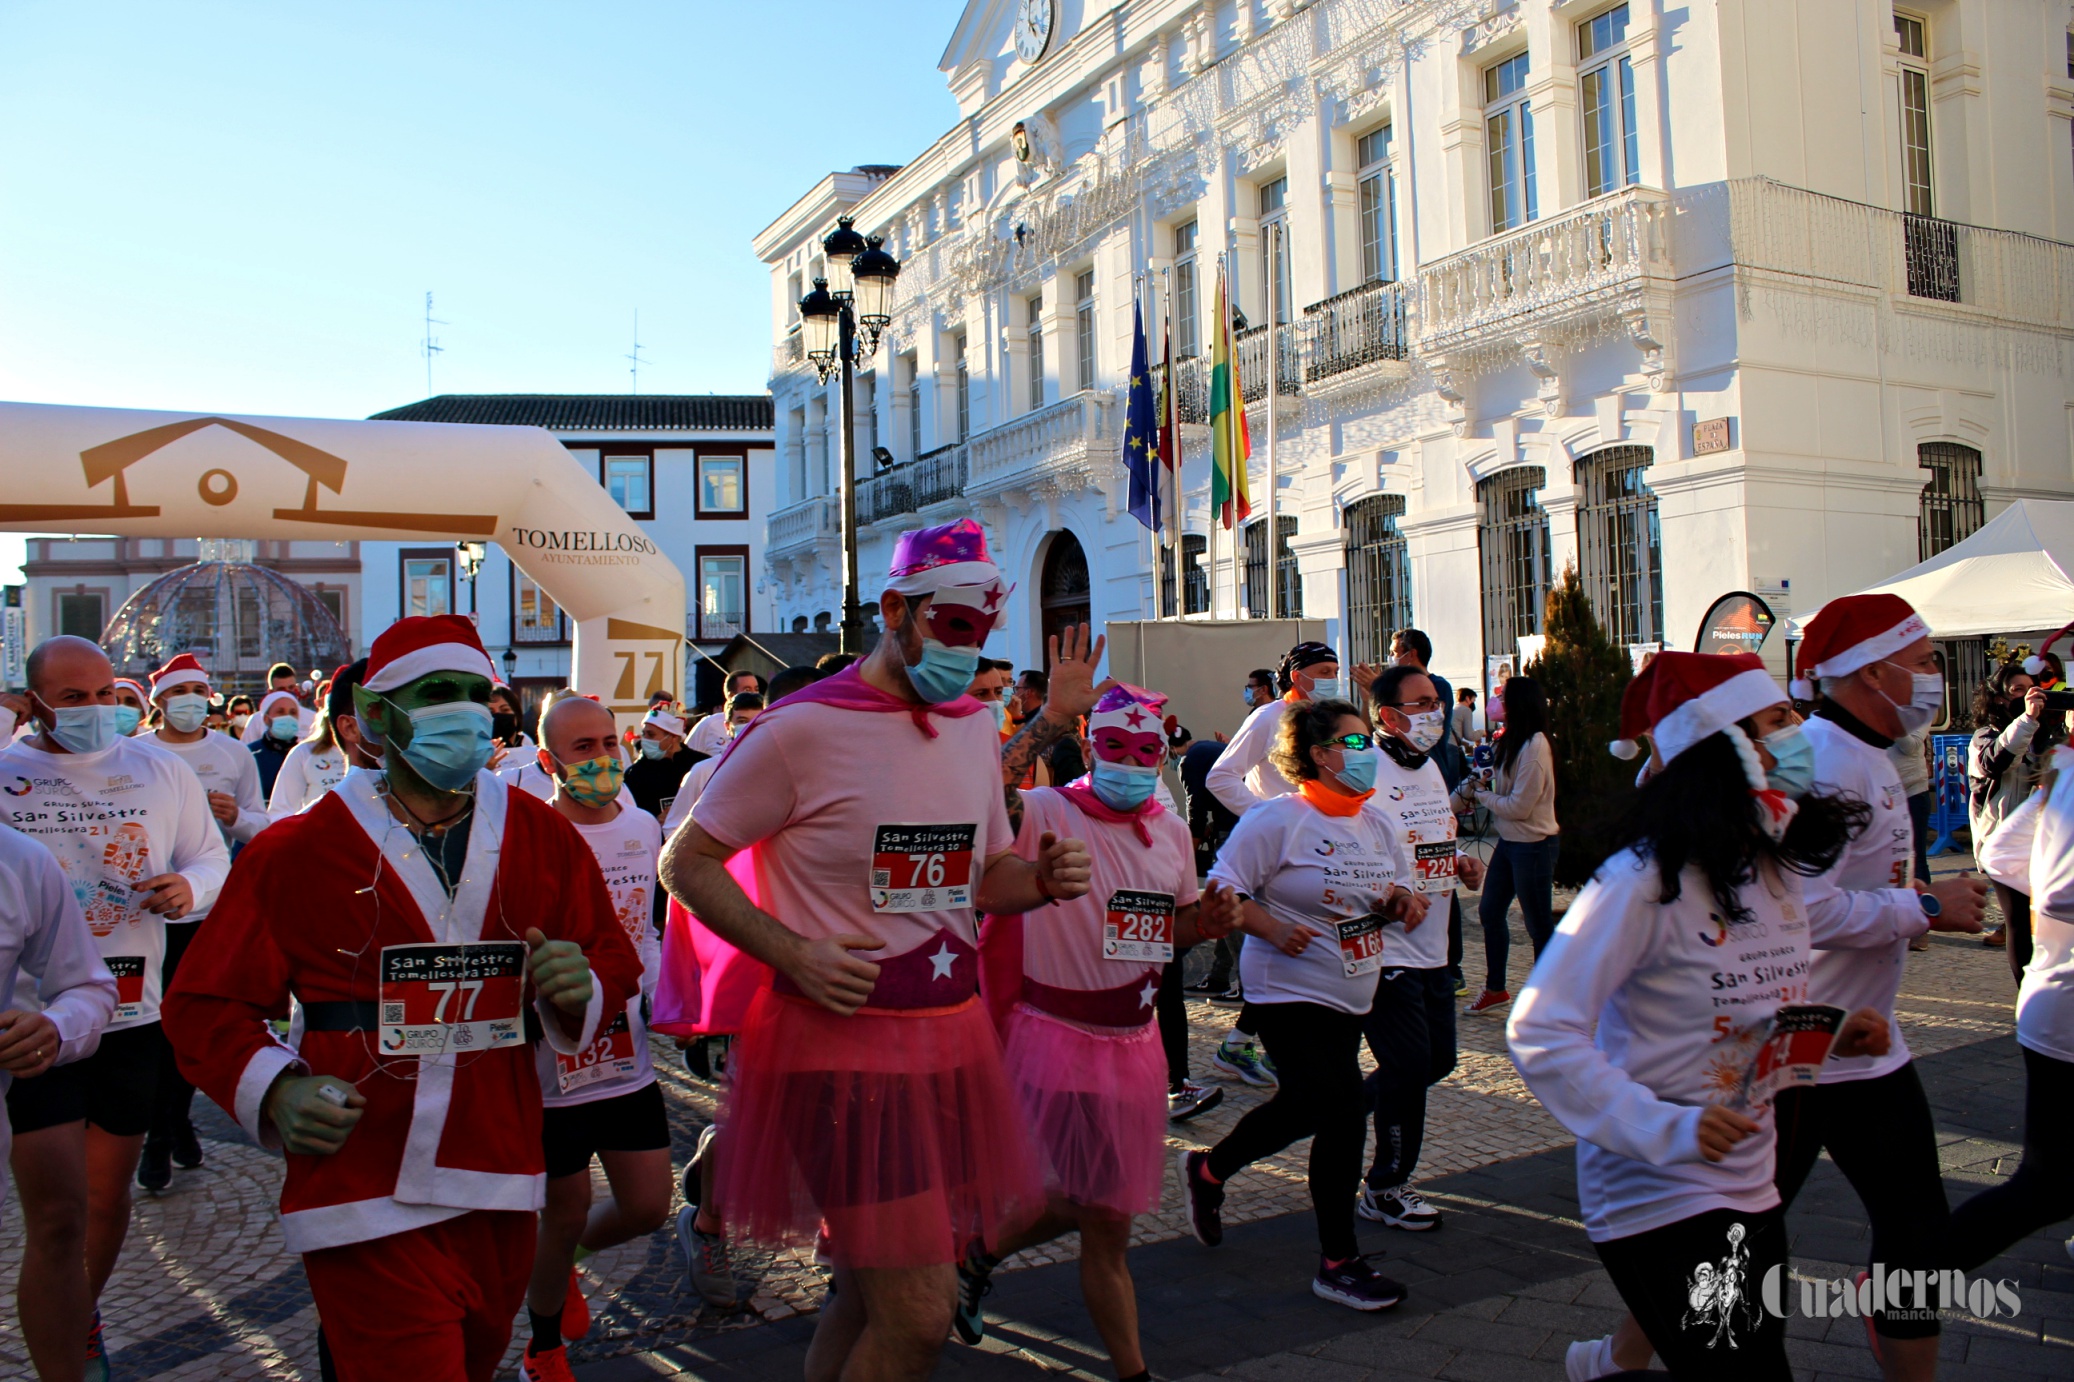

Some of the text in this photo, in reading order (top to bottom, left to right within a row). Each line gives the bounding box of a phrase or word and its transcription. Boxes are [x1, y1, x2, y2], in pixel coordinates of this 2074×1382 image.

[1703, 422, 1723, 432] PLAZA
[1697, 438, 1724, 451] ESPAÑA
[512, 527, 657, 555] TOMELLOSO
[541, 553, 640, 566] AYUNTAMIENTO
[1712, 631, 1741, 639] Pieles
[98, 783, 145, 796] TOMELLOSO
[12, 808, 148, 822] San Silvestre
[1400, 811, 1420, 820] San
[90, 825, 109, 836] 21
[881, 831, 969, 843] San Silvestre
[879, 844, 945, 853] Tomellosera
[908, 853, 946, 888] 76
[1323, 866, 1348, 877] San
[1428, 856, 1455, 878] 224
[1111, 895, 1133, 904] San
[1122, 913, 1166, 942] 282
[390, 957, 426, 970] San
[388, 968, 480, 980] Tomellosera
[1711, 972, 1748, 990] San
[428, 980, 485, 1022] 77
[406, 1029, 438, 1039] GRUPO
[405, 1037, 445, 1049] SURCO
